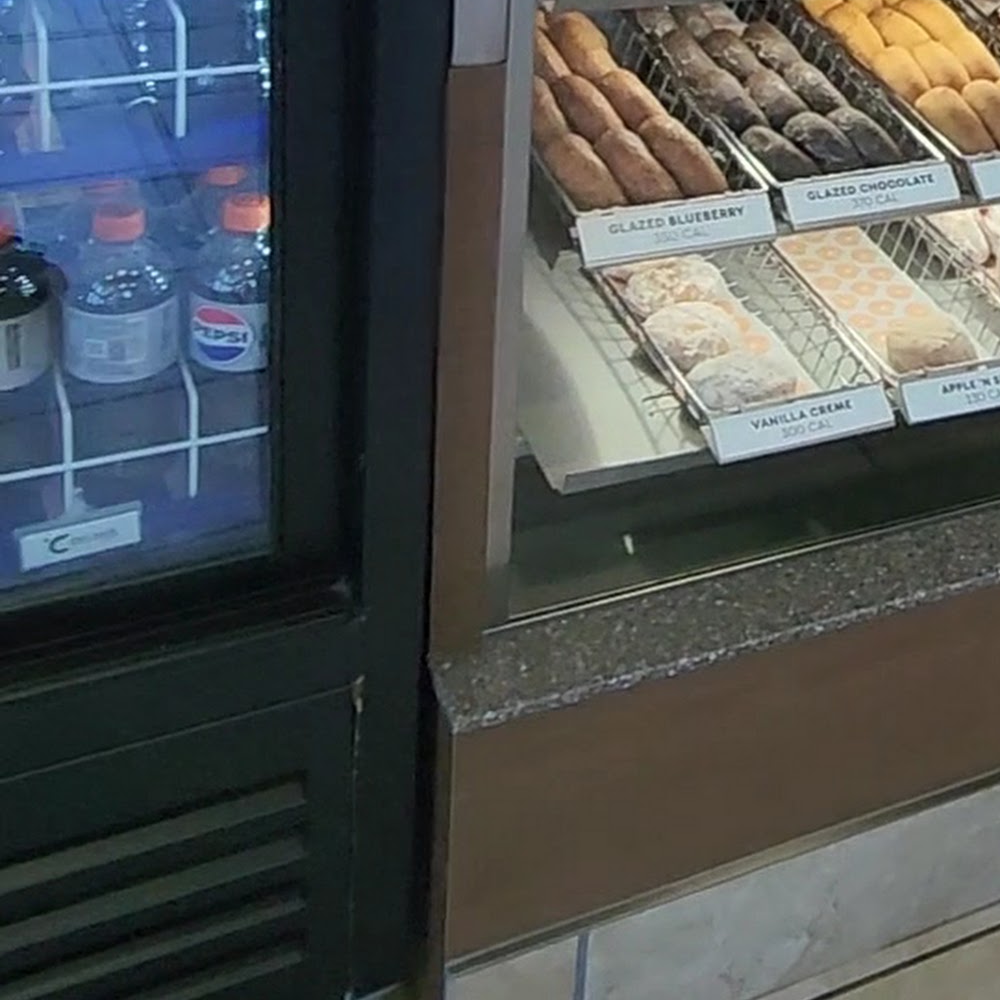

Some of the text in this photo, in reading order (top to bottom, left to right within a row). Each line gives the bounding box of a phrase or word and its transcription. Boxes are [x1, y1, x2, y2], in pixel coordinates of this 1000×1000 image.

[806, 173, 935, 201] GLAZED CHOCOLATE
[875, 193, 898, 206] CAL
[608, 206, 745, 235] GLAZED BLUEBERRY
[193, 322, 248, 344] PEPSI
[942, 379, 976, 395] APPLE
[750, 399, 853, 430] VANILLA CREME
[808, 419, 833, 433] CAL
